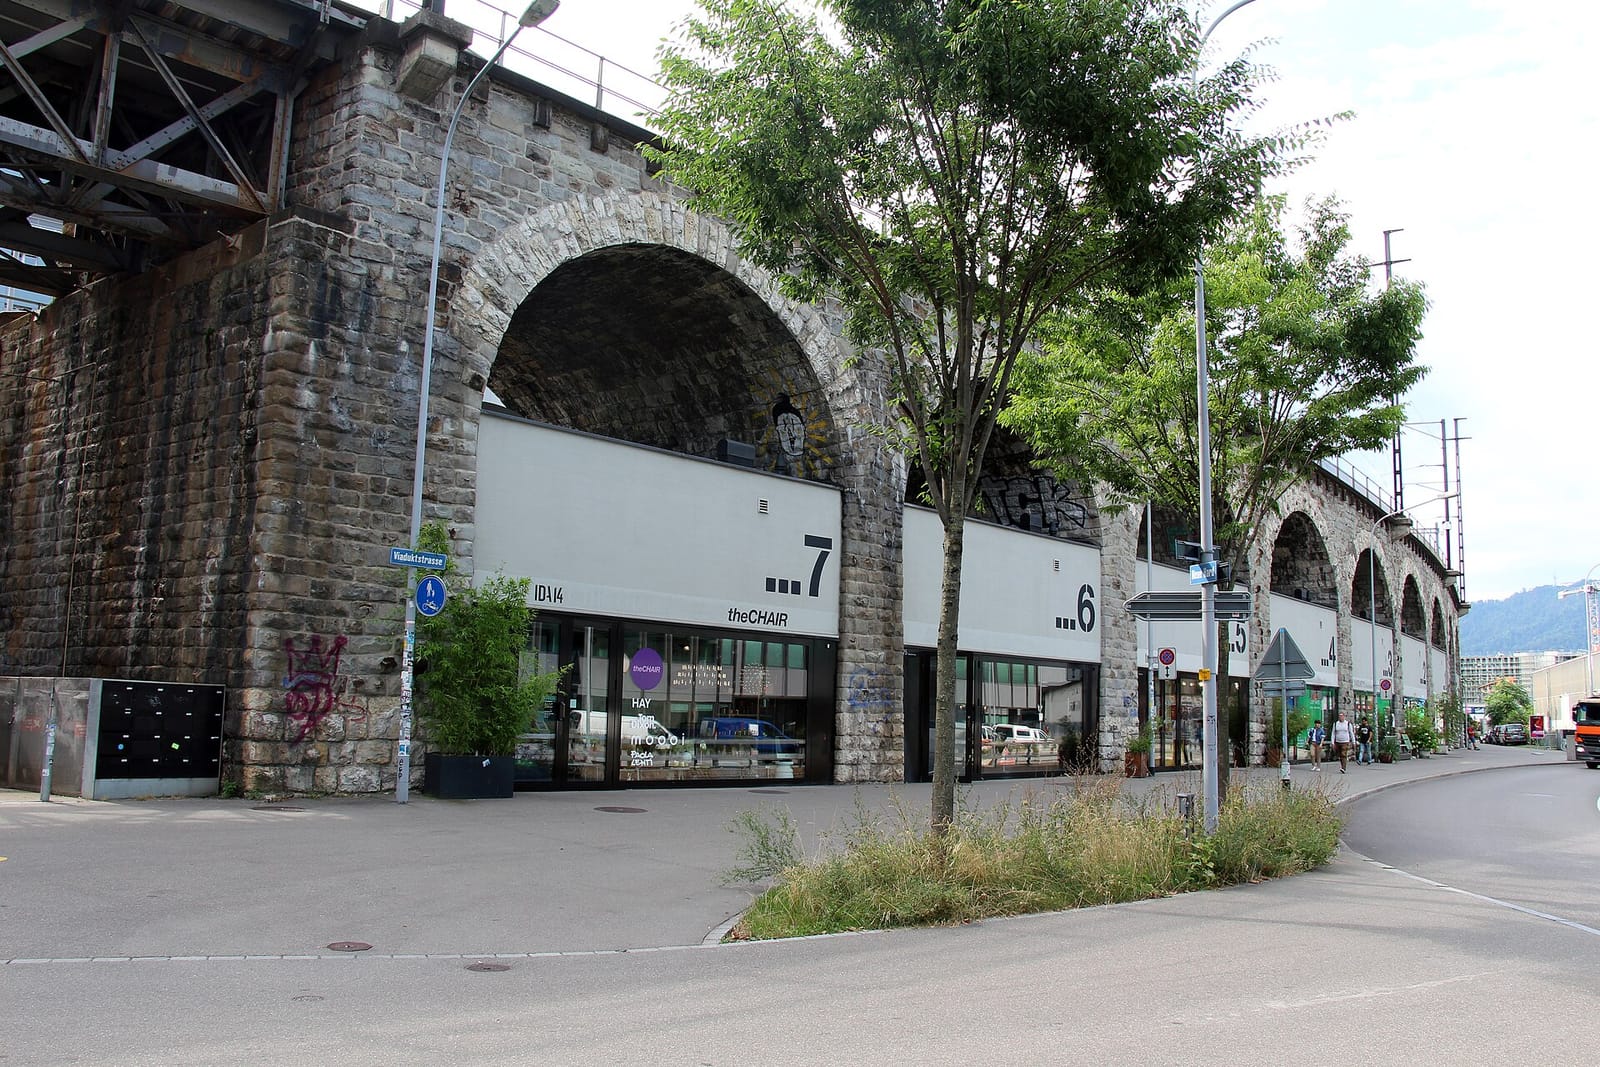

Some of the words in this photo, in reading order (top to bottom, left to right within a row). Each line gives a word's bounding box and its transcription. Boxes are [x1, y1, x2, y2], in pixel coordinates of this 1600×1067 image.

[393, 551, 443, 566] Viaduktstrasse
[728, 608, 788, 627] theCHAIR
[632, 665, 661, 673] theCHAIR
[631, 698, 651, 709] HAY
